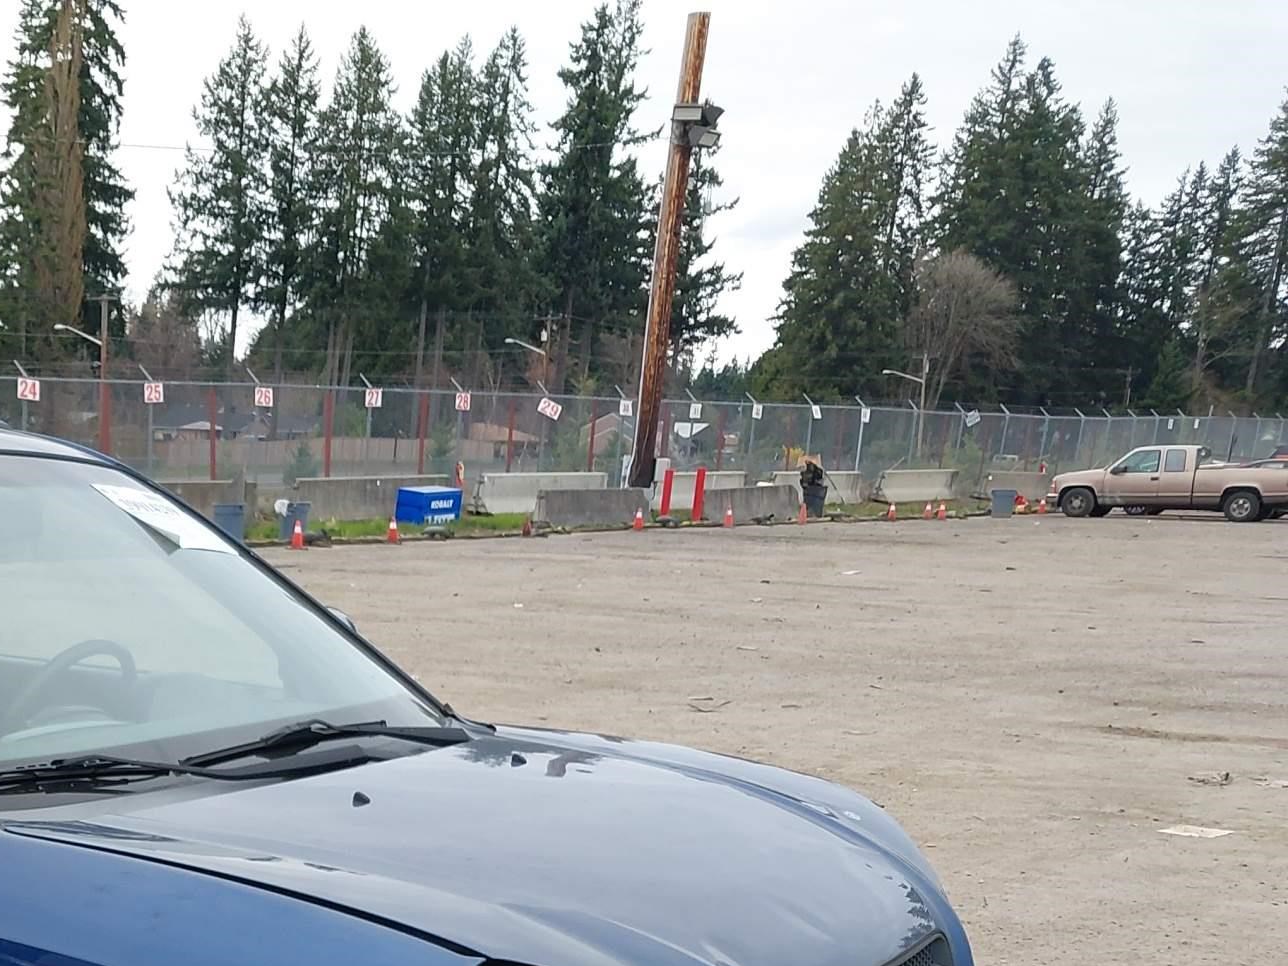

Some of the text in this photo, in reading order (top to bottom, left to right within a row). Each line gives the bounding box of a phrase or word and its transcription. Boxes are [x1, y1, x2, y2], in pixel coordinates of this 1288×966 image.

[20, 380, 37, 398] 24
[146, 384, 161, 401] 25
[257, 388, 271, 405] 26
[367, 390, 379, 406] 27
[541, 400, 559, 418] 29
